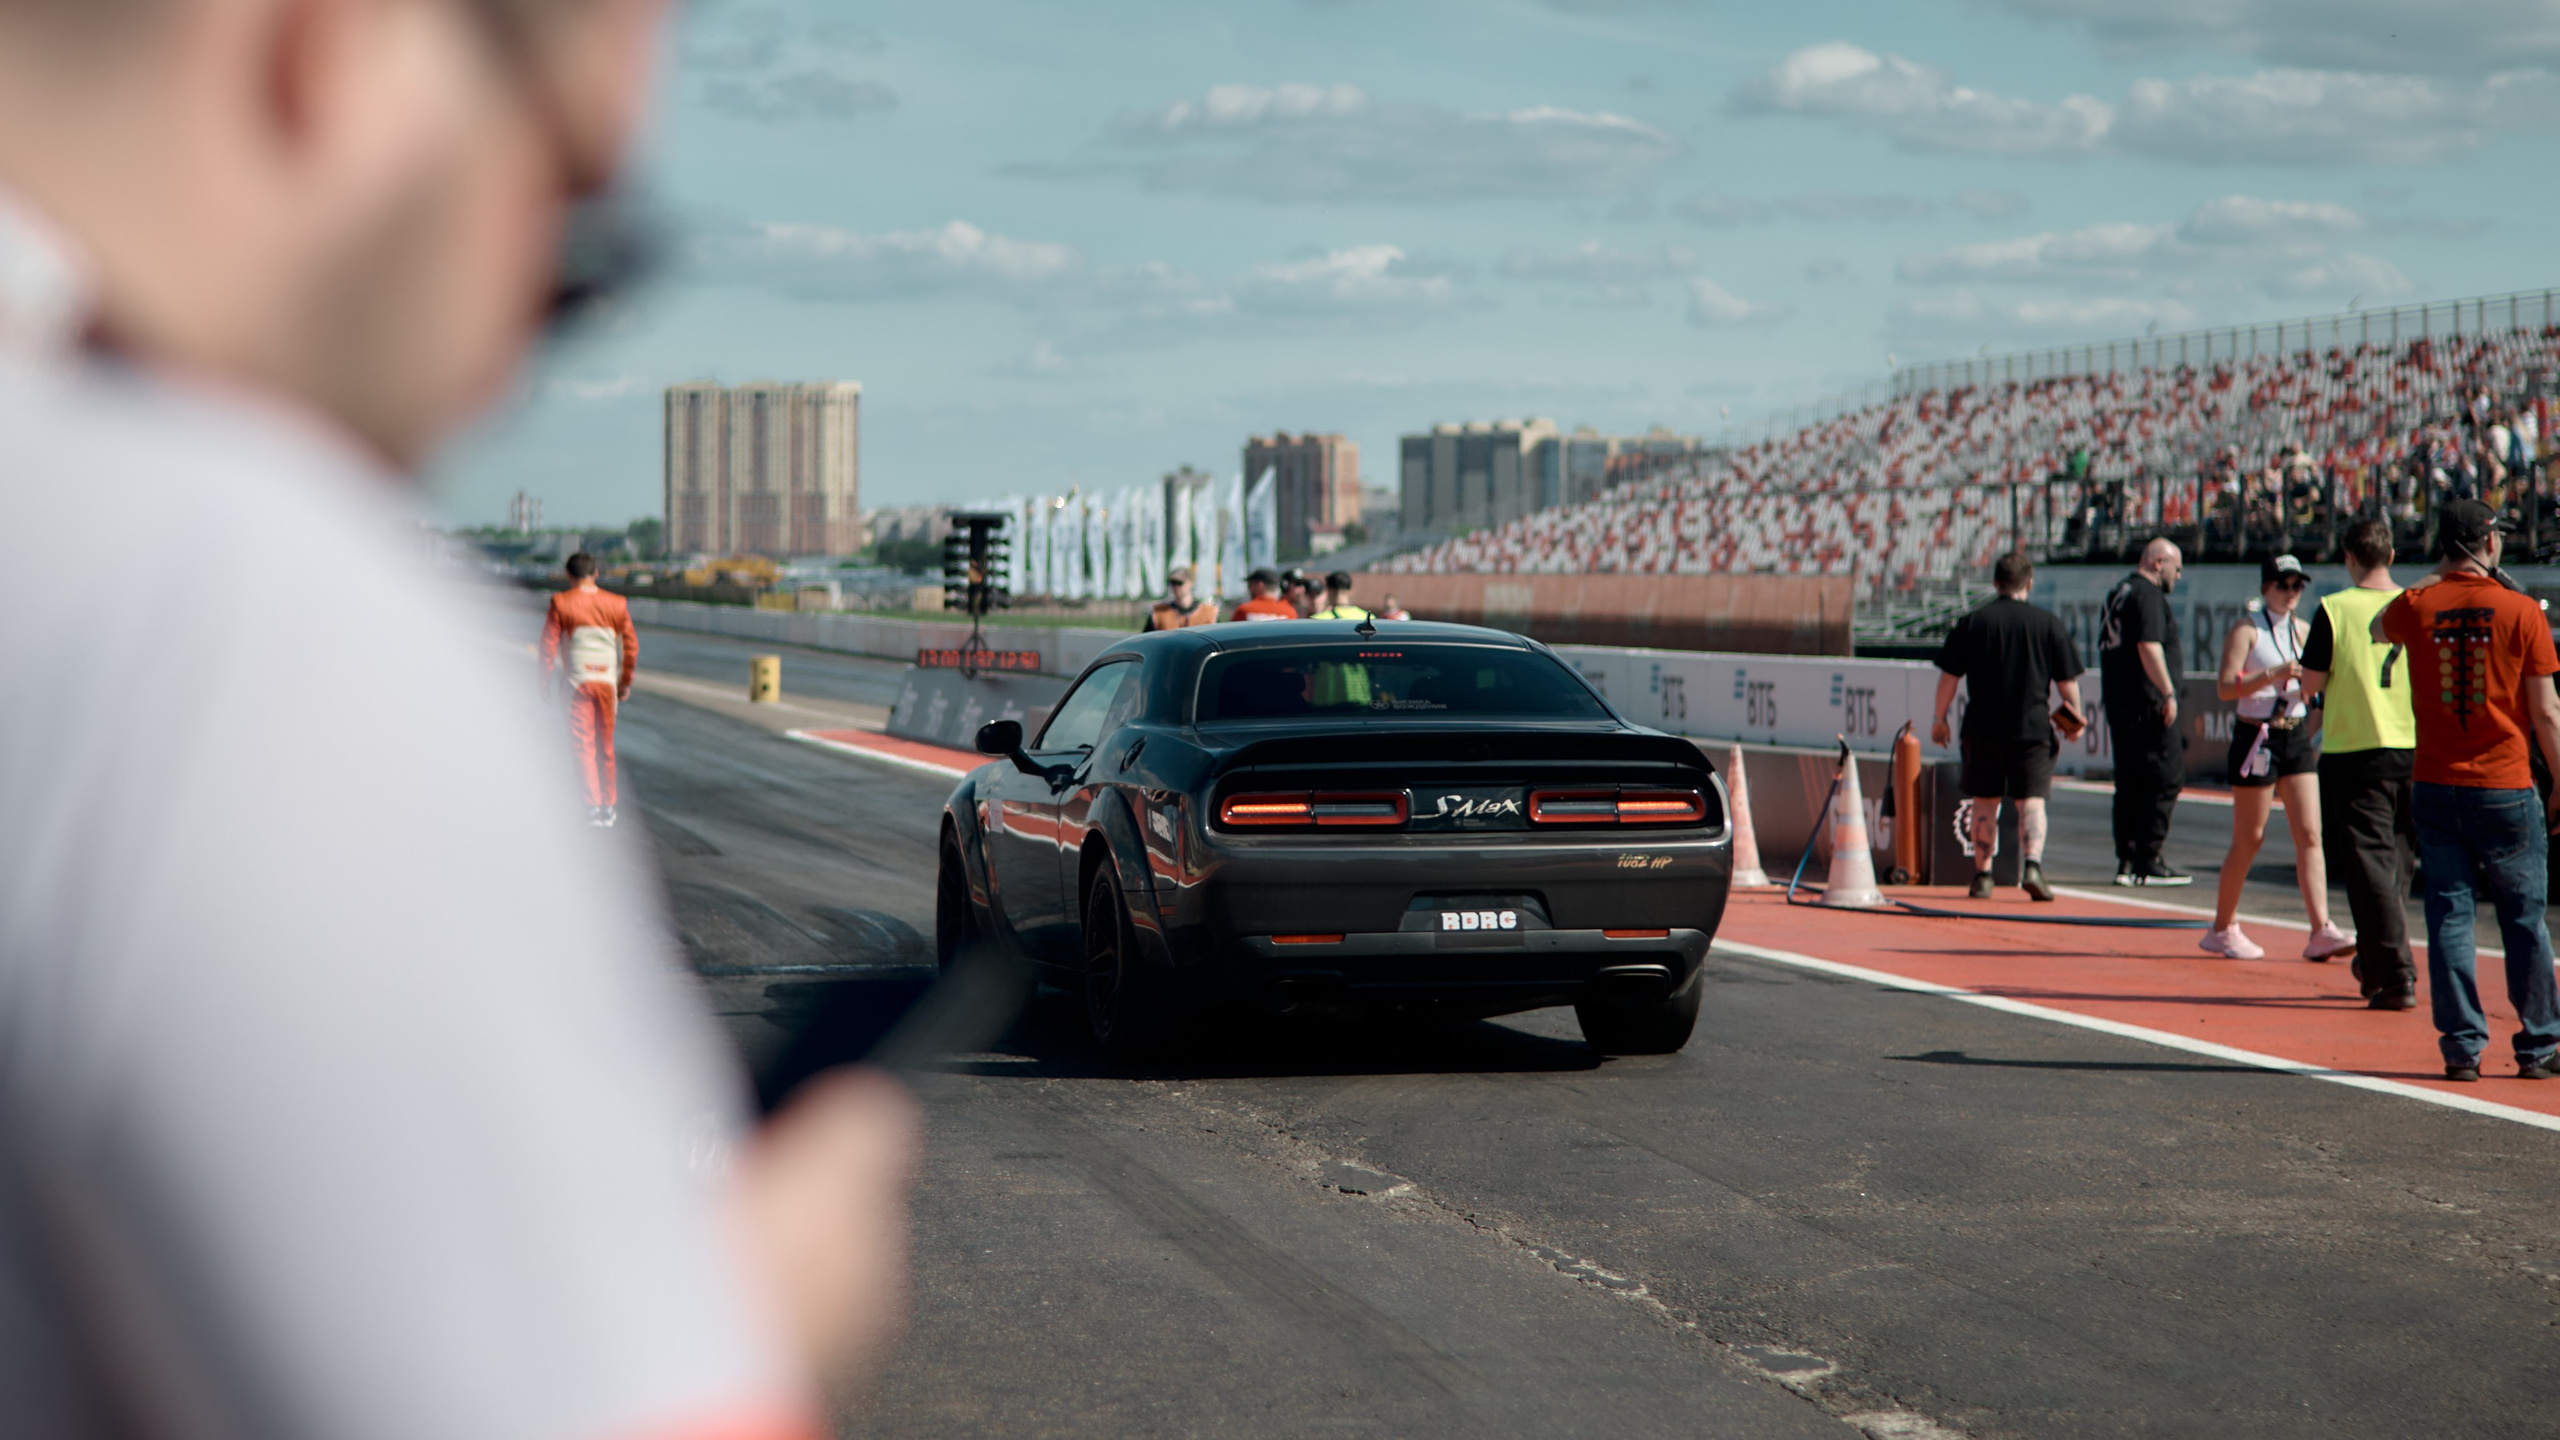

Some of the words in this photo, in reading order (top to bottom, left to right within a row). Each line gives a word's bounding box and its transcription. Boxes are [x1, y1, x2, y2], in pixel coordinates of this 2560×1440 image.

[1747, 680, 1777, 728] ВТБ
[1846, 685, 1878, 736] ВТБ
[1650, 855, 1673, 870] HP
[1441, 911, 1517, 931] RDRC
